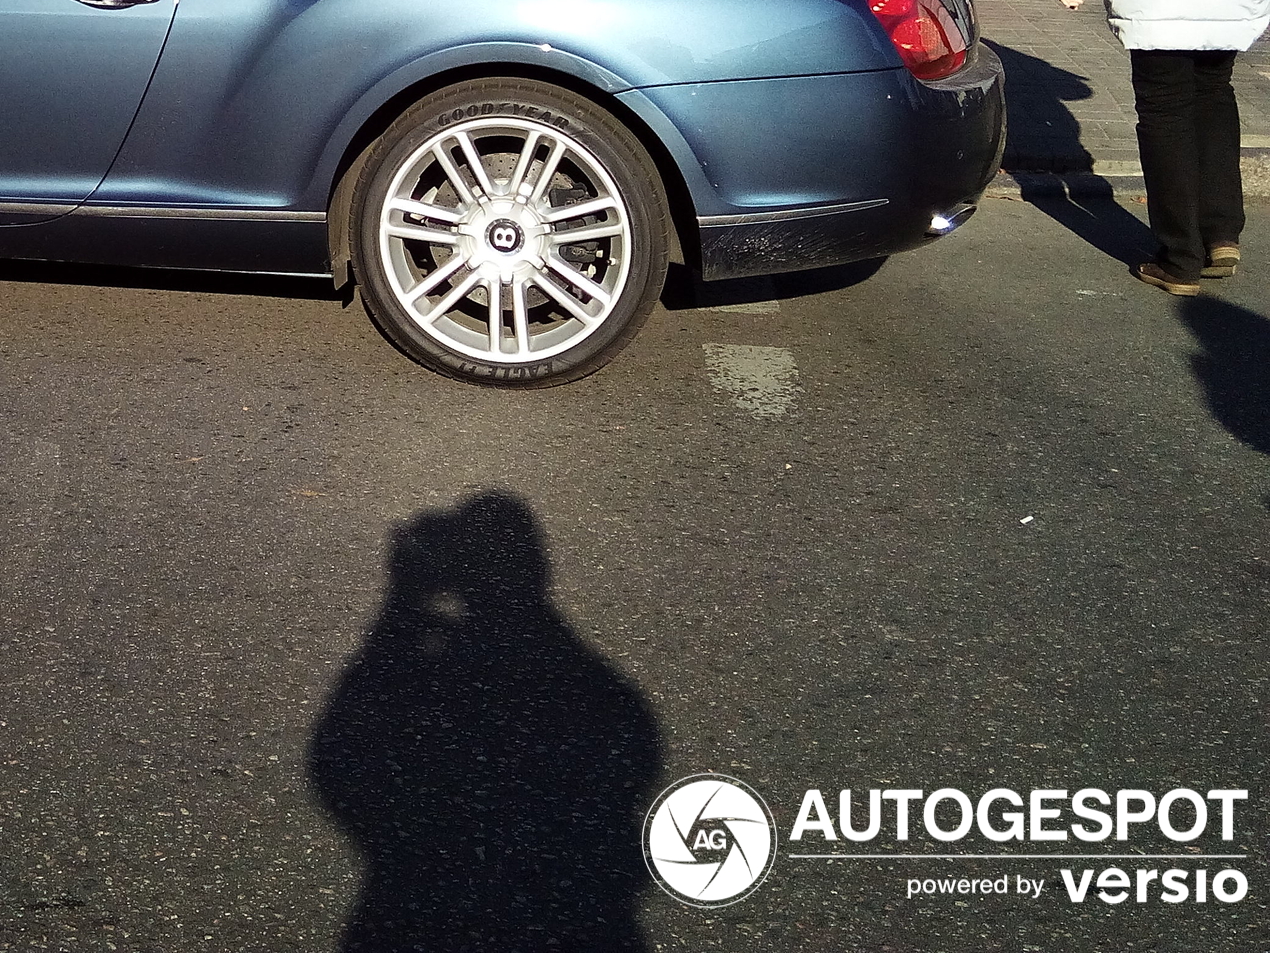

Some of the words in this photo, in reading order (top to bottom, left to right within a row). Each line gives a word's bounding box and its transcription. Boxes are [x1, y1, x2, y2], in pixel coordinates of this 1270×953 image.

[437, 102, 570, 130] GOODYEAR
[492, 226, 517, 250] B
[484, 362, 553, 381] EAGLE
